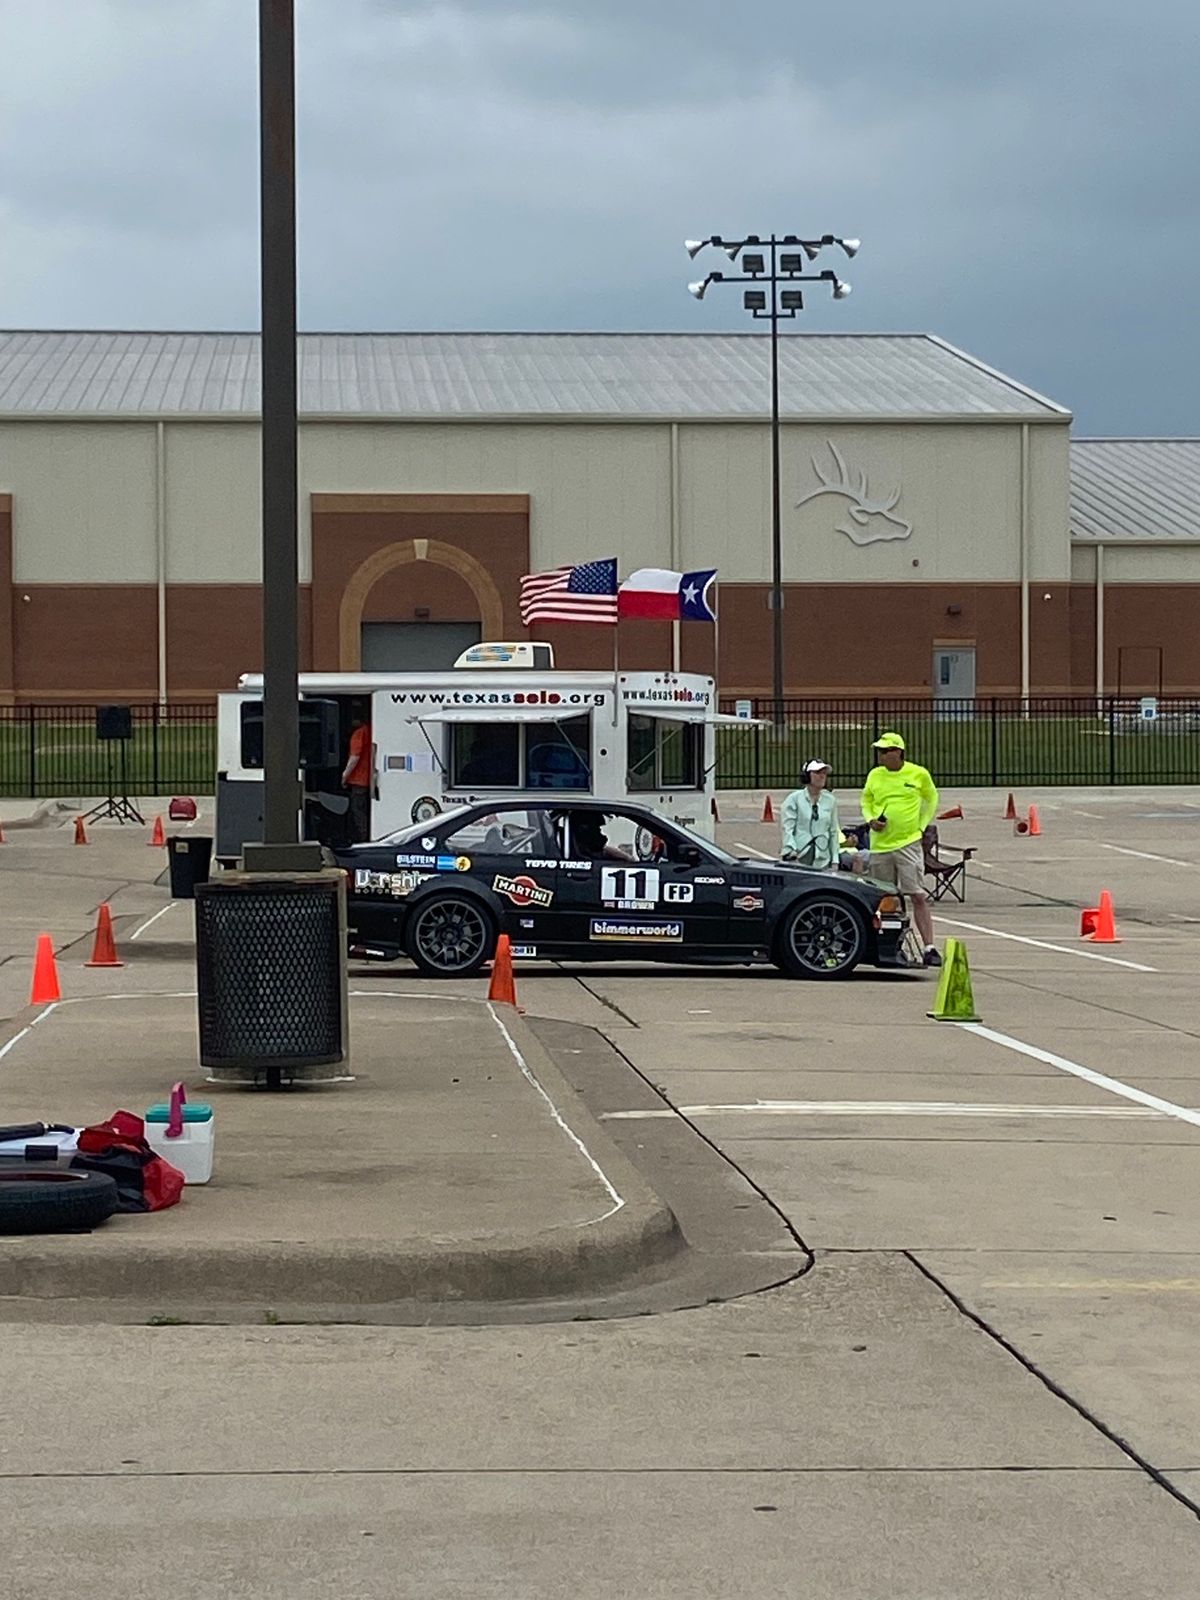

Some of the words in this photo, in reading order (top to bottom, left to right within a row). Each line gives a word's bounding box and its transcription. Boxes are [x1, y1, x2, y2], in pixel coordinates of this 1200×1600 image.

[396, 854, 436, 865] BILSTEIN
[525, 859, 557, 868] TOYO
[559, 861, 592, 870] TIRES
[498, 879, 547, 902] MARTINI
[608, 870, 646, 899] 11
[668, 885, 691, 900] FP
[617, 901, 655, 910] BROWN
[594, 922, 680, 936] bimmerworld
